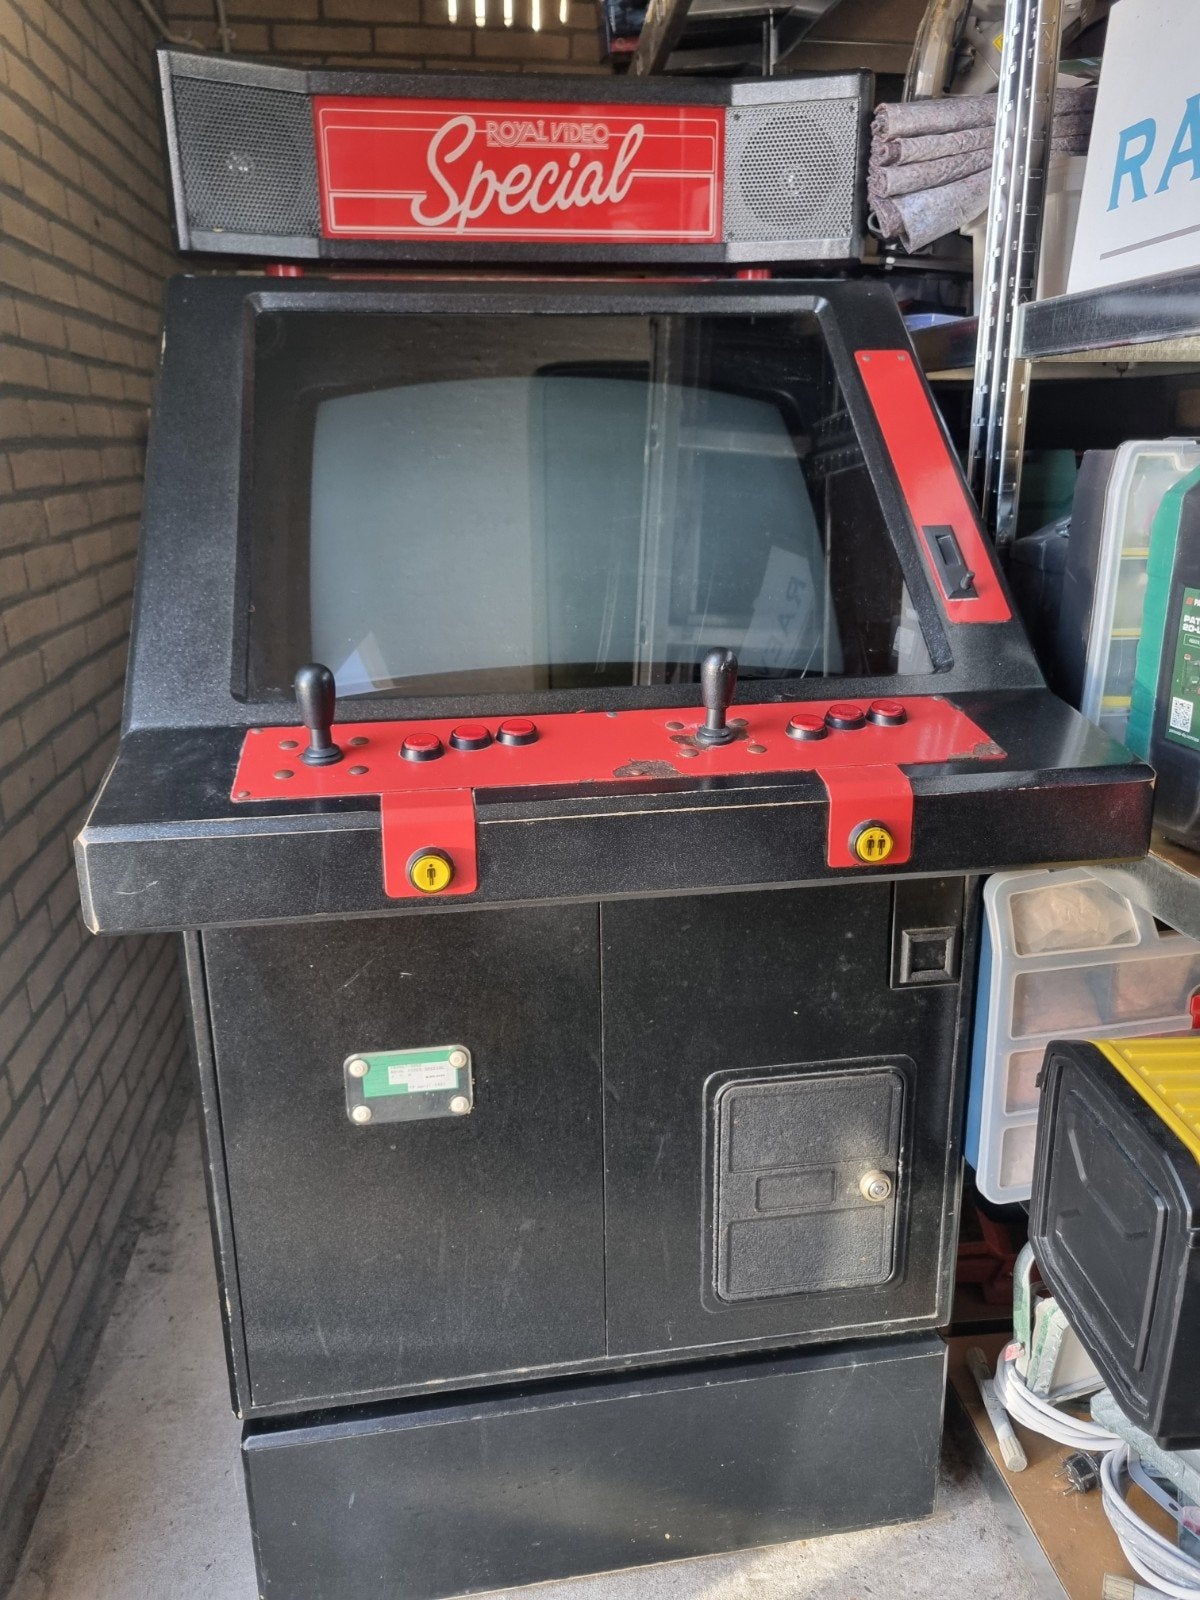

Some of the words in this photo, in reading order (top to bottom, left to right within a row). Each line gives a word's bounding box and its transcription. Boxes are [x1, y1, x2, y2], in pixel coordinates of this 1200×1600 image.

[486, 120, 549, 146] ROYAL
[551, 122, 609, 144] VIDEO
[411, 115, 644, 234] Special
